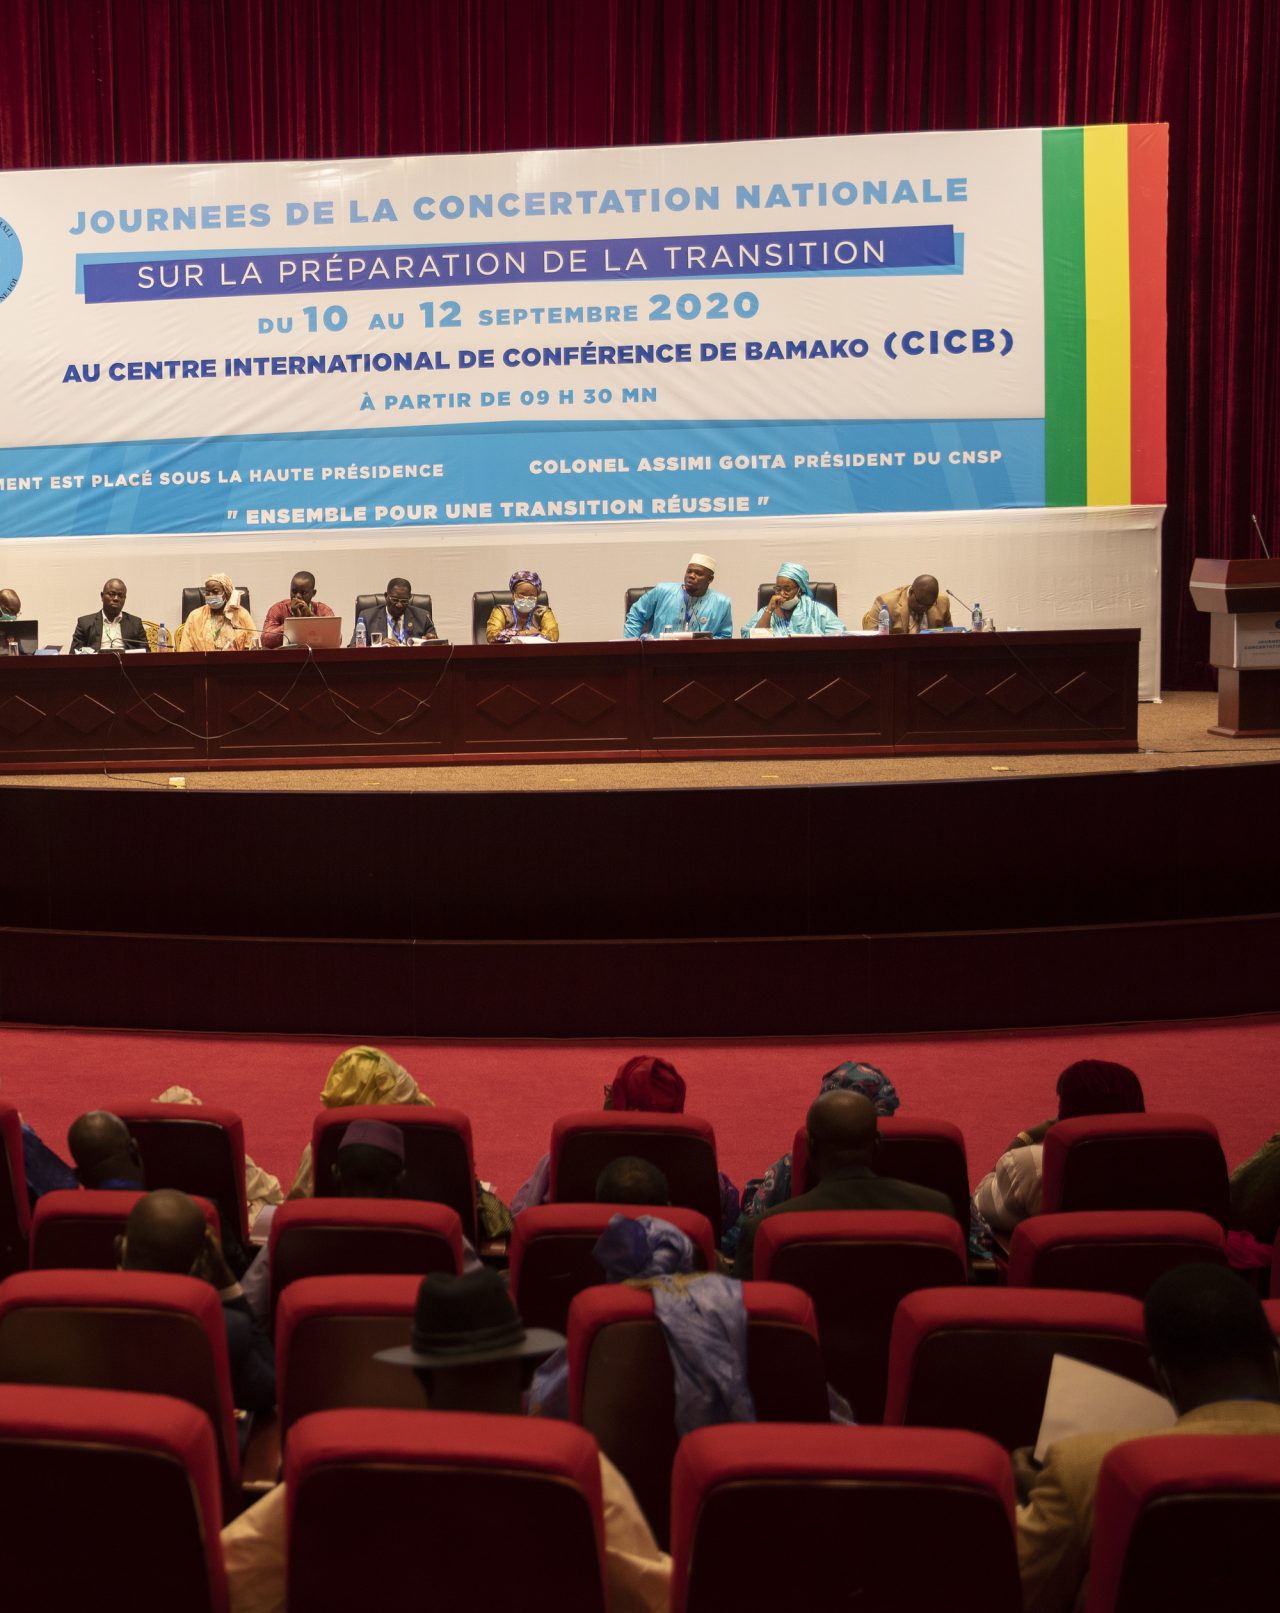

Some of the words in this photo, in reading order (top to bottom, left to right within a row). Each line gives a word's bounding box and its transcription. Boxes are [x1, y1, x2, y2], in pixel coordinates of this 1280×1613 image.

[69, 203, 270, 235] JOURNEES
[286, 201, 334, 226] DE
[350, 199, 398, 223] LA
[413, 186, 719, 221] CONCERTATION
[736, 178, 968, 209] NATIONALE
[138, 265, 204, 289] SUR
[221, 262, 263, 286] LA
[279, 252, 525, 283] PRÉPARATION
[544, 250, 587, 273] DE
[605, 248, 647, 271] LA
[664, 240, 884, 269] TRANSITION
[258, 317, 293, 334] DU
[303, 305, 348, 333] 10
[369, 313, 404, 330] AU
[419, 301, 462, 328] 12
[478, 306, 638, 326] SEPTEMBRE
[648, 291, 759, 321] 2020
[62, 364, 100, 383] AU
[109, 359, 216, 381] CENTRE
[224, 351, 450, 376] INTERNATIONAL
[459, 349, 494, 369] DE
[502, 341, 692, 367] CONFÉRENCE
[700, 343, 737, 362] DE
[745, 339, 869, 360] BAMAKO
[884, 328, 1013, 360] (CICB)
[359, 392, 376, 411] À
[384, 392, 471, 410] PARTIR
[480, 392, 510, 407] DE
[520, 390, 549, 406] 09
[559, 390, 573, 405] H
[584, 389, 612, 404] 30
[622, 387, 657, 403] MN
[50, 475, 84, 489] EST
[92, 470, 152, 488] PLACÉ
[160, 471, 210, 485] SOUS
[218, 470, 242, 484] LA
[250, 468, 314, 483] HAUTE
[322, 463, 444, 480] PRÉSIDENCE
[529, 458, 629, 475] COLONEL
[637, 456, 711, 472] ASSIMI
[720, 454, 786, 470] GOITA
[794, 451, 905, 468] PRÉSIDENT
[914, 452, 941, 465] DU
[948, 450, 1002, 464] CNSP
[247, 506, 367, 525] ENSEMBLE
[375, 504, 437, 521] POUR
[446, 502, 492, 518] UNE
[501, 499, 643, 517] TRANSITION
[652, 494, 749, 514] RÉUSSIE
